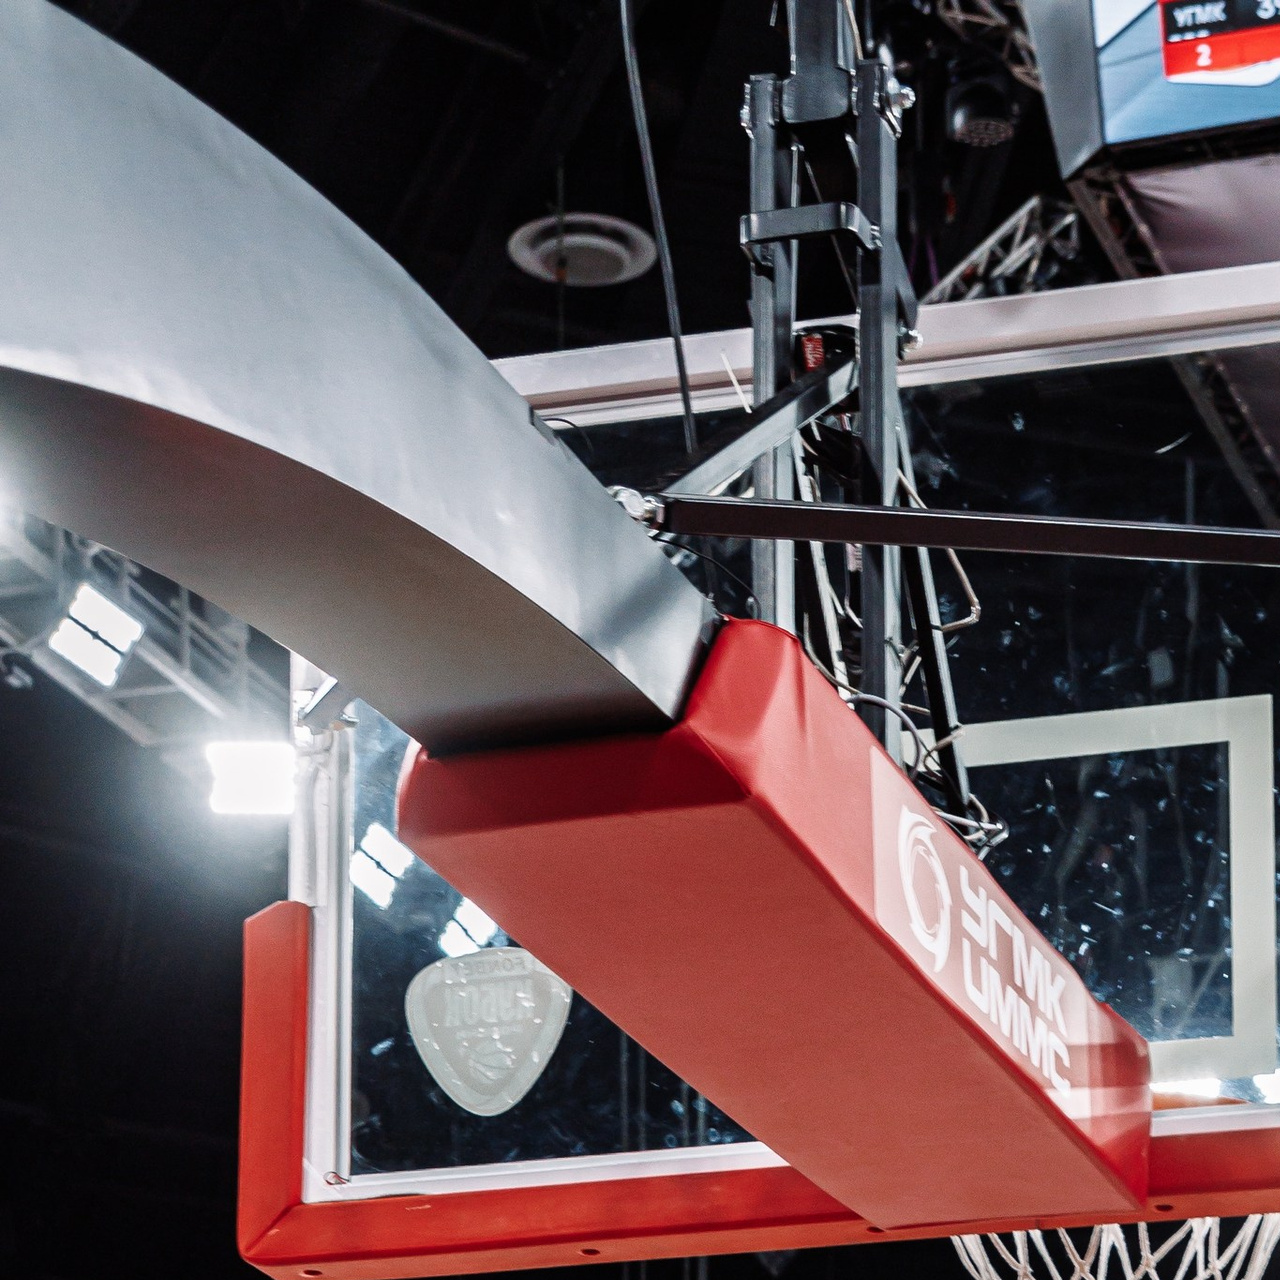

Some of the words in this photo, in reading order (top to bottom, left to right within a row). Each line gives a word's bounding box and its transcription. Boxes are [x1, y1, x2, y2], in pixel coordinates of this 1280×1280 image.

[1195, 43, 1212, 67] 2
[959, 864, 1067, 1038] УГМК
[962, 937, 1072, 1099] UMMC
